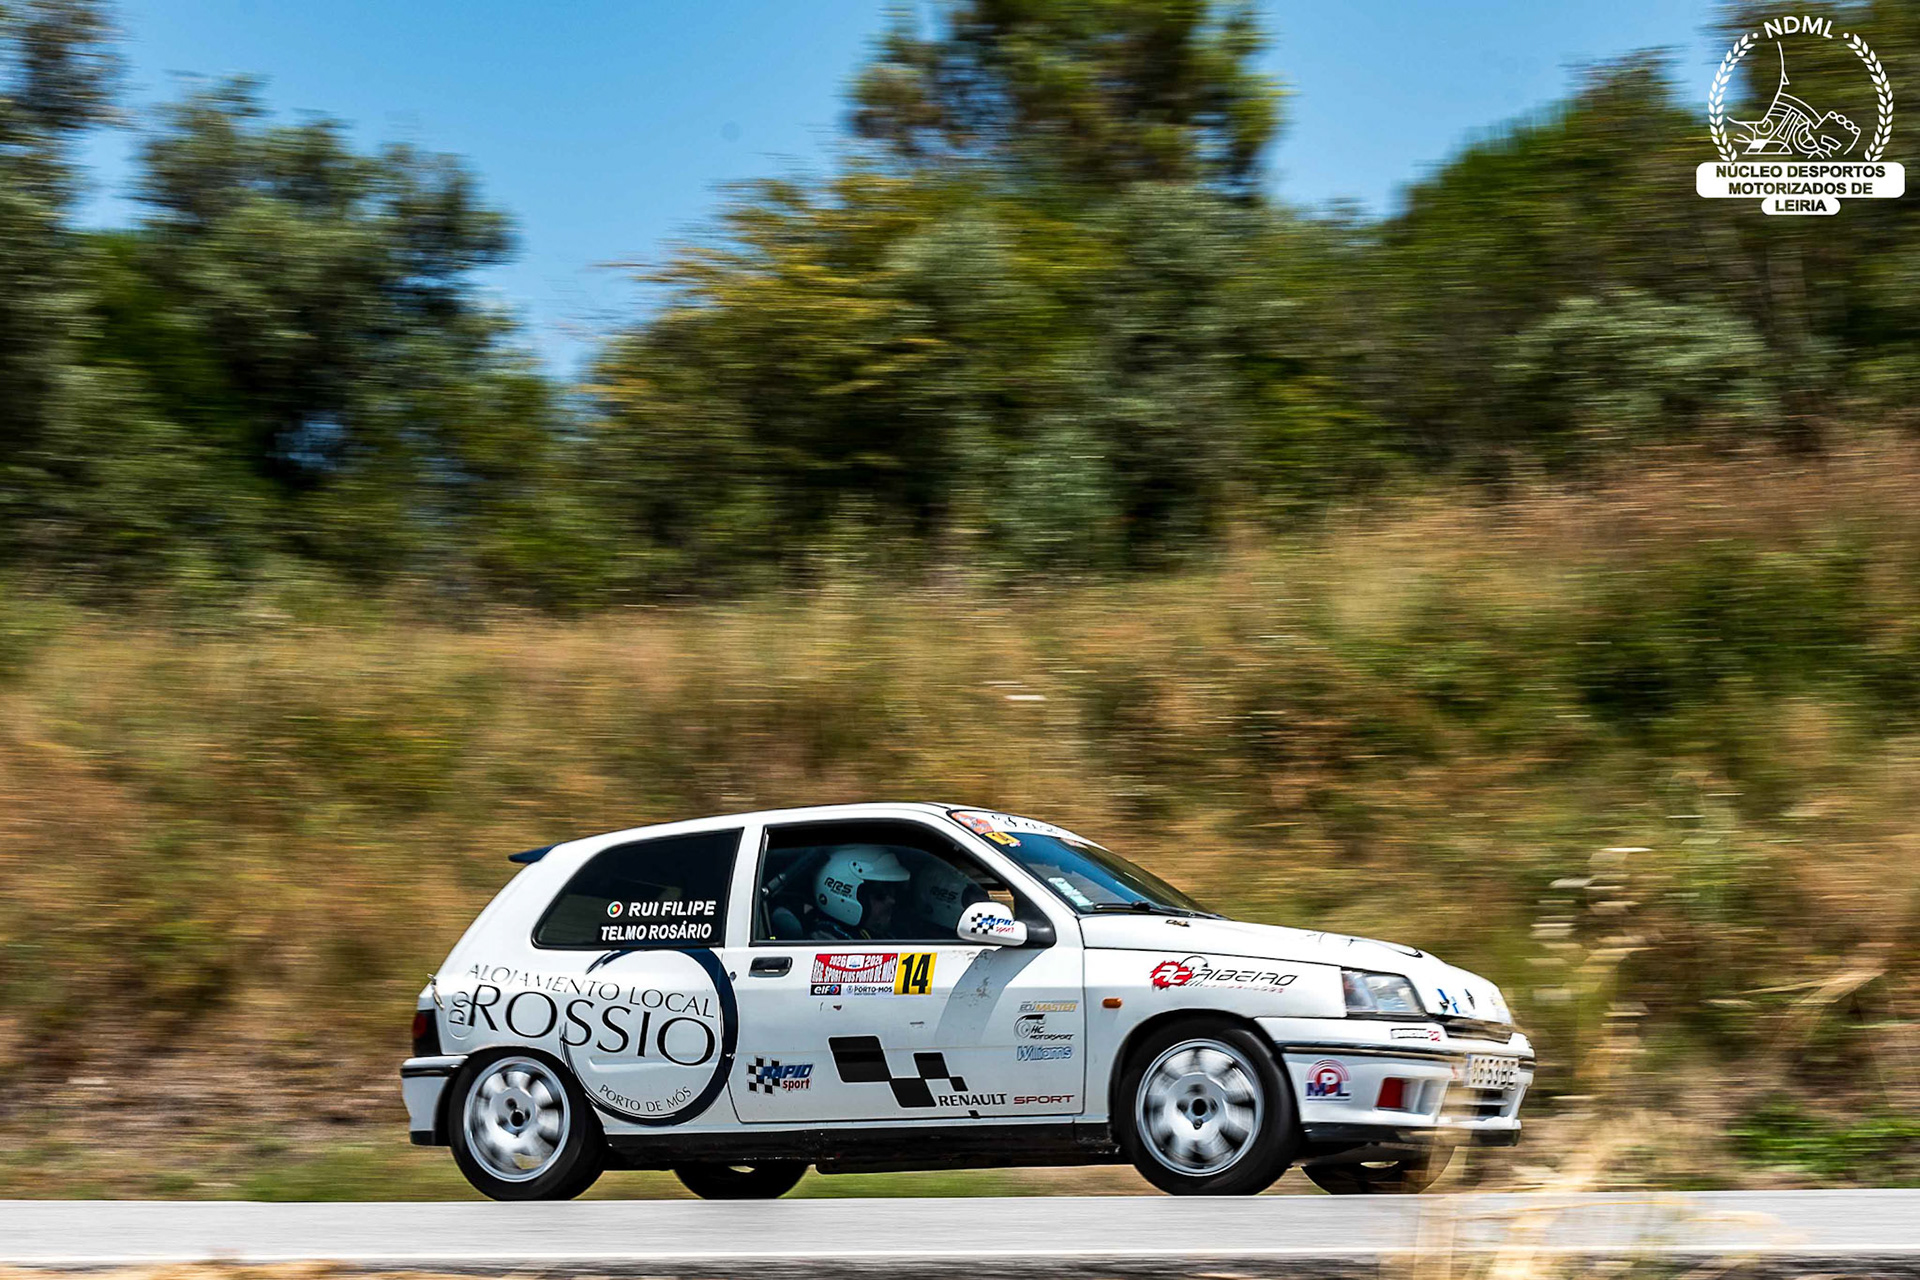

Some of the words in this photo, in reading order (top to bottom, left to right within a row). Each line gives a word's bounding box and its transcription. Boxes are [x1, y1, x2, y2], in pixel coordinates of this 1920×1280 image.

[824, 877, 853, 894] RRS
[628, 902, 659, 917] RUI
[661, 901, 717, 916] FILIPE
[601, 925, 647, 941] TELMO
[649, 920, 712, 939] ROSÁRIO
[902, 954, 931, 994] 14
[1194, 968, 1299, 987] RIBEIRO
[467, 963, 620, 1001] ALOJAMENTO
[629, 987, 715, 1018] LOCAL
[814, 986, 830, 995] elf
[468, 984, 716, 1067] ROSSIO
[1030, 1024, 1045, 1034] HC
[1029, 1033, 1075, 1041] MOTORSPORT
[1017, 1045, 1072, 1061] Williams
[782, 1079, 811, 1091] sport
[599, 1084, 641, 1111] PORTO
[646, 1101, 662, 1112] DE
[666, 1086, 692, 1109] MÓS
[938, 1093, 1007, 1107] RENAULT
[1013, 1095, 1075, 1105] SPORT
